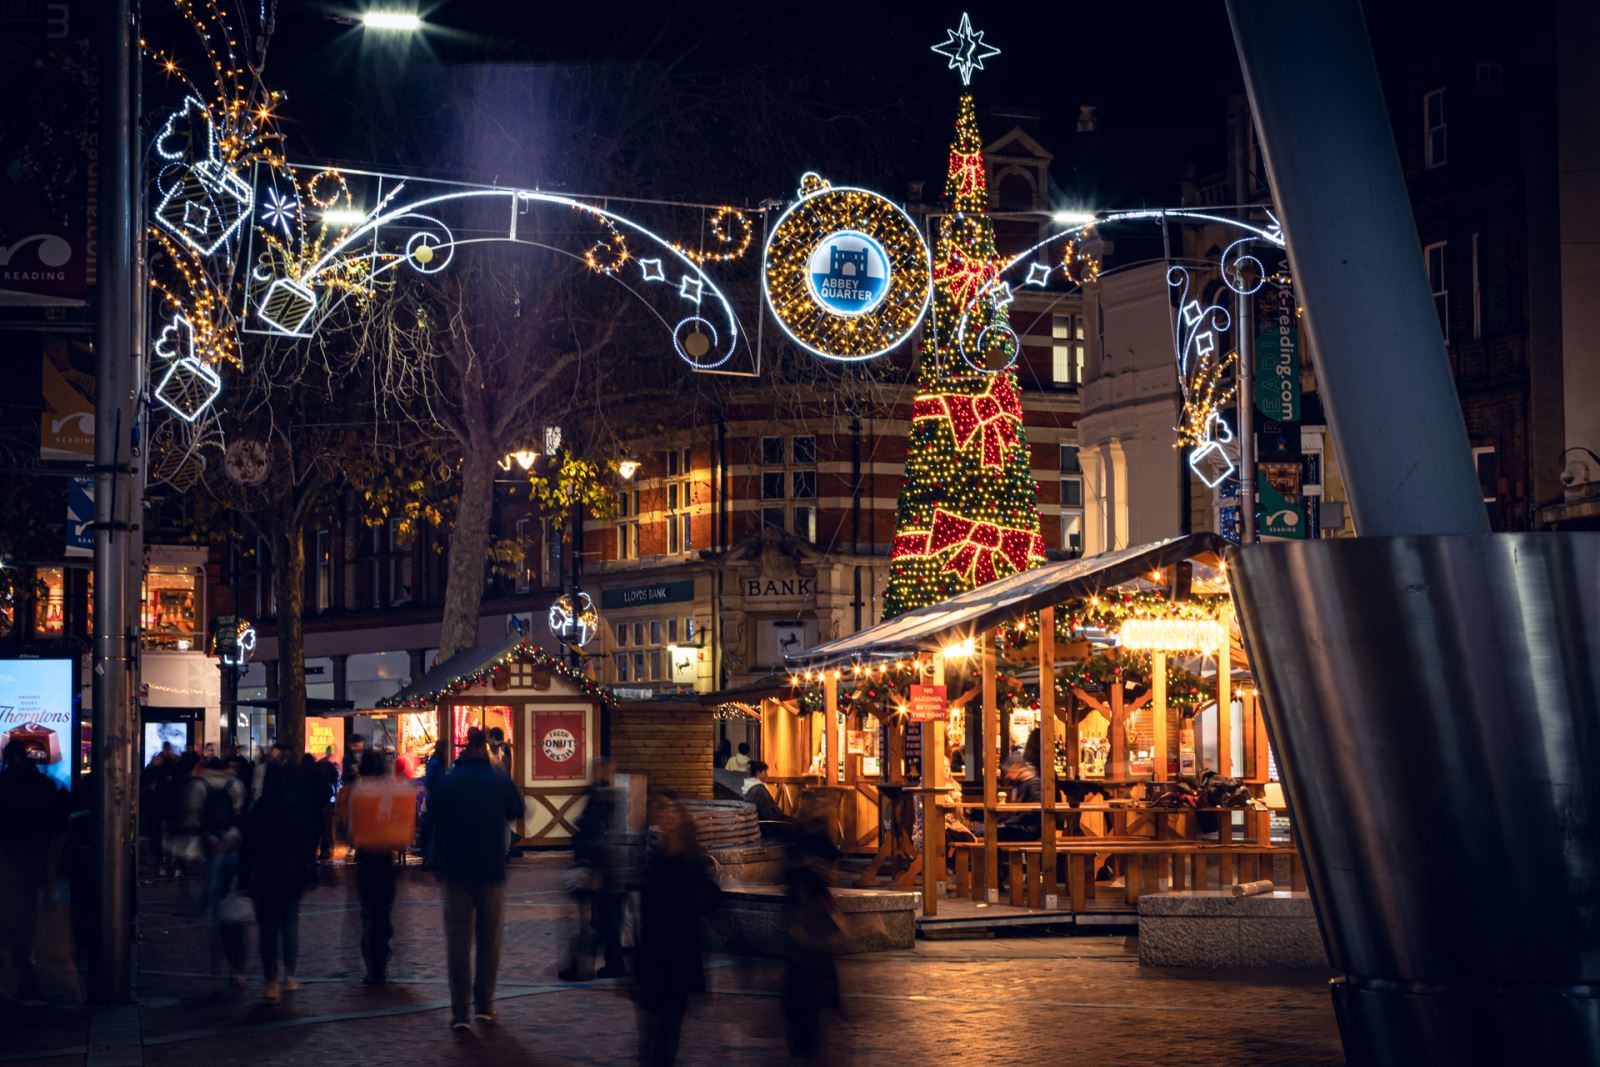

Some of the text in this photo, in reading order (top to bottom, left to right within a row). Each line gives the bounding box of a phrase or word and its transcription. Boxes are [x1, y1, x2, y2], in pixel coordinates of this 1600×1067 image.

[4, 271, 66, 281] READING
[822, 277, 859, 290] ABBEY
[820, 288, 873, 301] QUARTER
[749, 579, 812, 596] BANK
[624, 587, 667, 602] LLOYDS BANK
[0, 705, 71, 723] Thorntons
[538, 739, 580, 749] DONUTS
